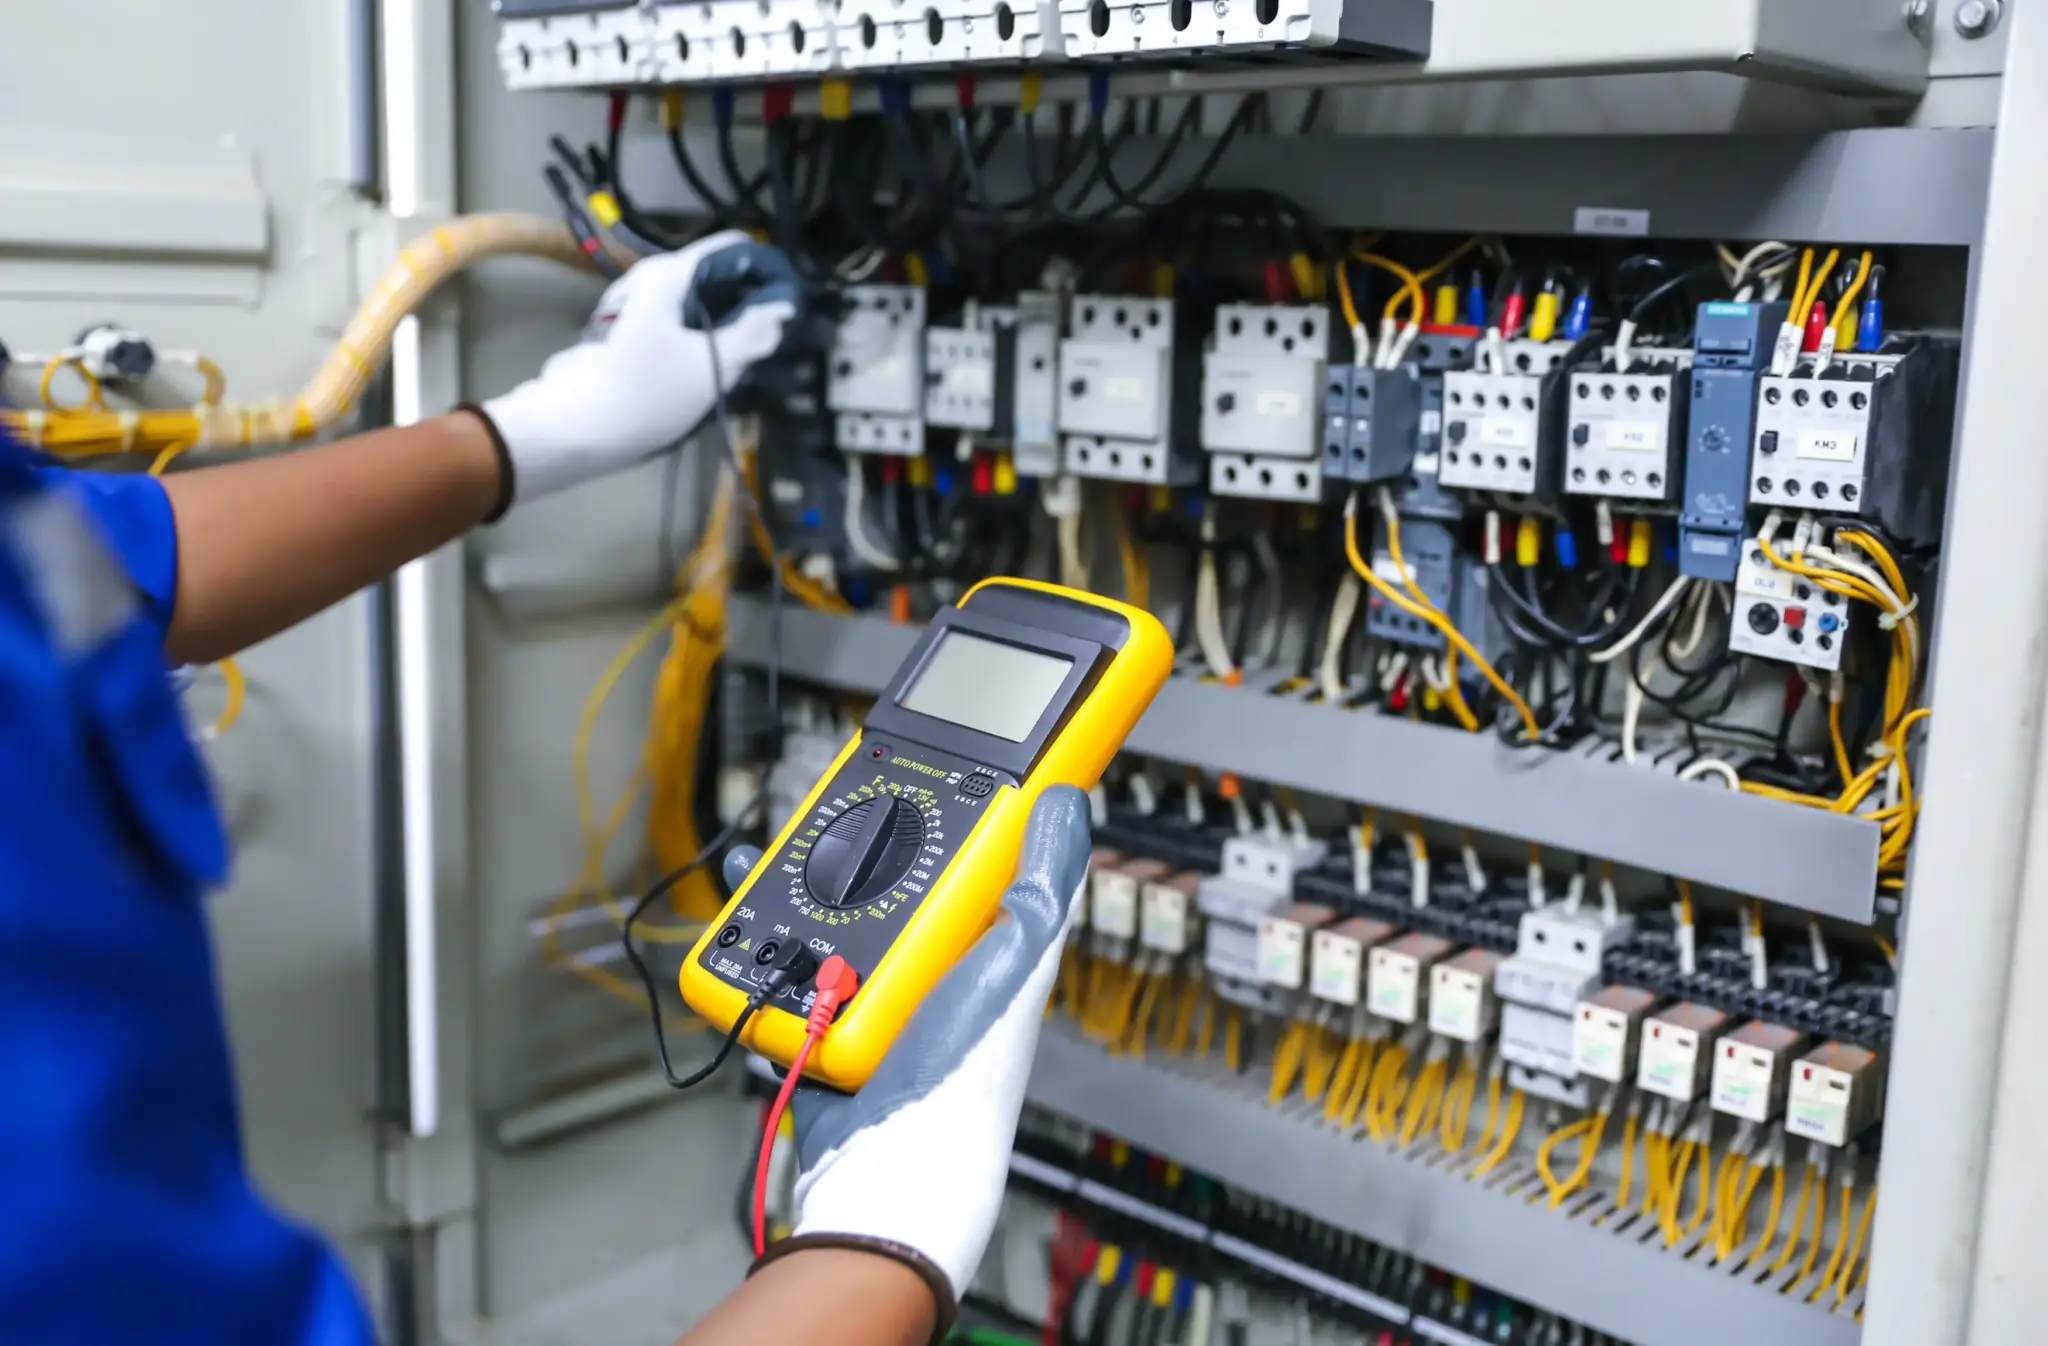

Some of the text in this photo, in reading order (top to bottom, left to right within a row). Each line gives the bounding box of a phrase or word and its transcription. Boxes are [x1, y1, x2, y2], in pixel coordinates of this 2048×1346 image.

[1814, 440, 1838, 450] KM3
[890, 756, 948, 779] AUTO POWER OFF
[872, 775, 884, 785] F
[904, 785, 918, 794] OFF
[930, 808, 942, 817] 200
[922, 858, 934, 867] 2M
[782, 864, 798, 874] 200m
[915, 870, 930, 880] 20M
[905, 881, 924, 893] 200M
[790, 897, 802, 906] 200
[894, 892, 909, 902] hFE
[737, 906, 756, 920] 20A
[798, 906, 810, 916] 750
[810, 911, 824, 921] 1000
[868, 908, 886, 920] 200m
[826, 916, 838, 925] 200
[773, 924, 790, 936] mA
[809, 938, 835, 955] COM
[720, 957, 733, 967] MAX
[714, 965, 740, 979] UNFUSED
